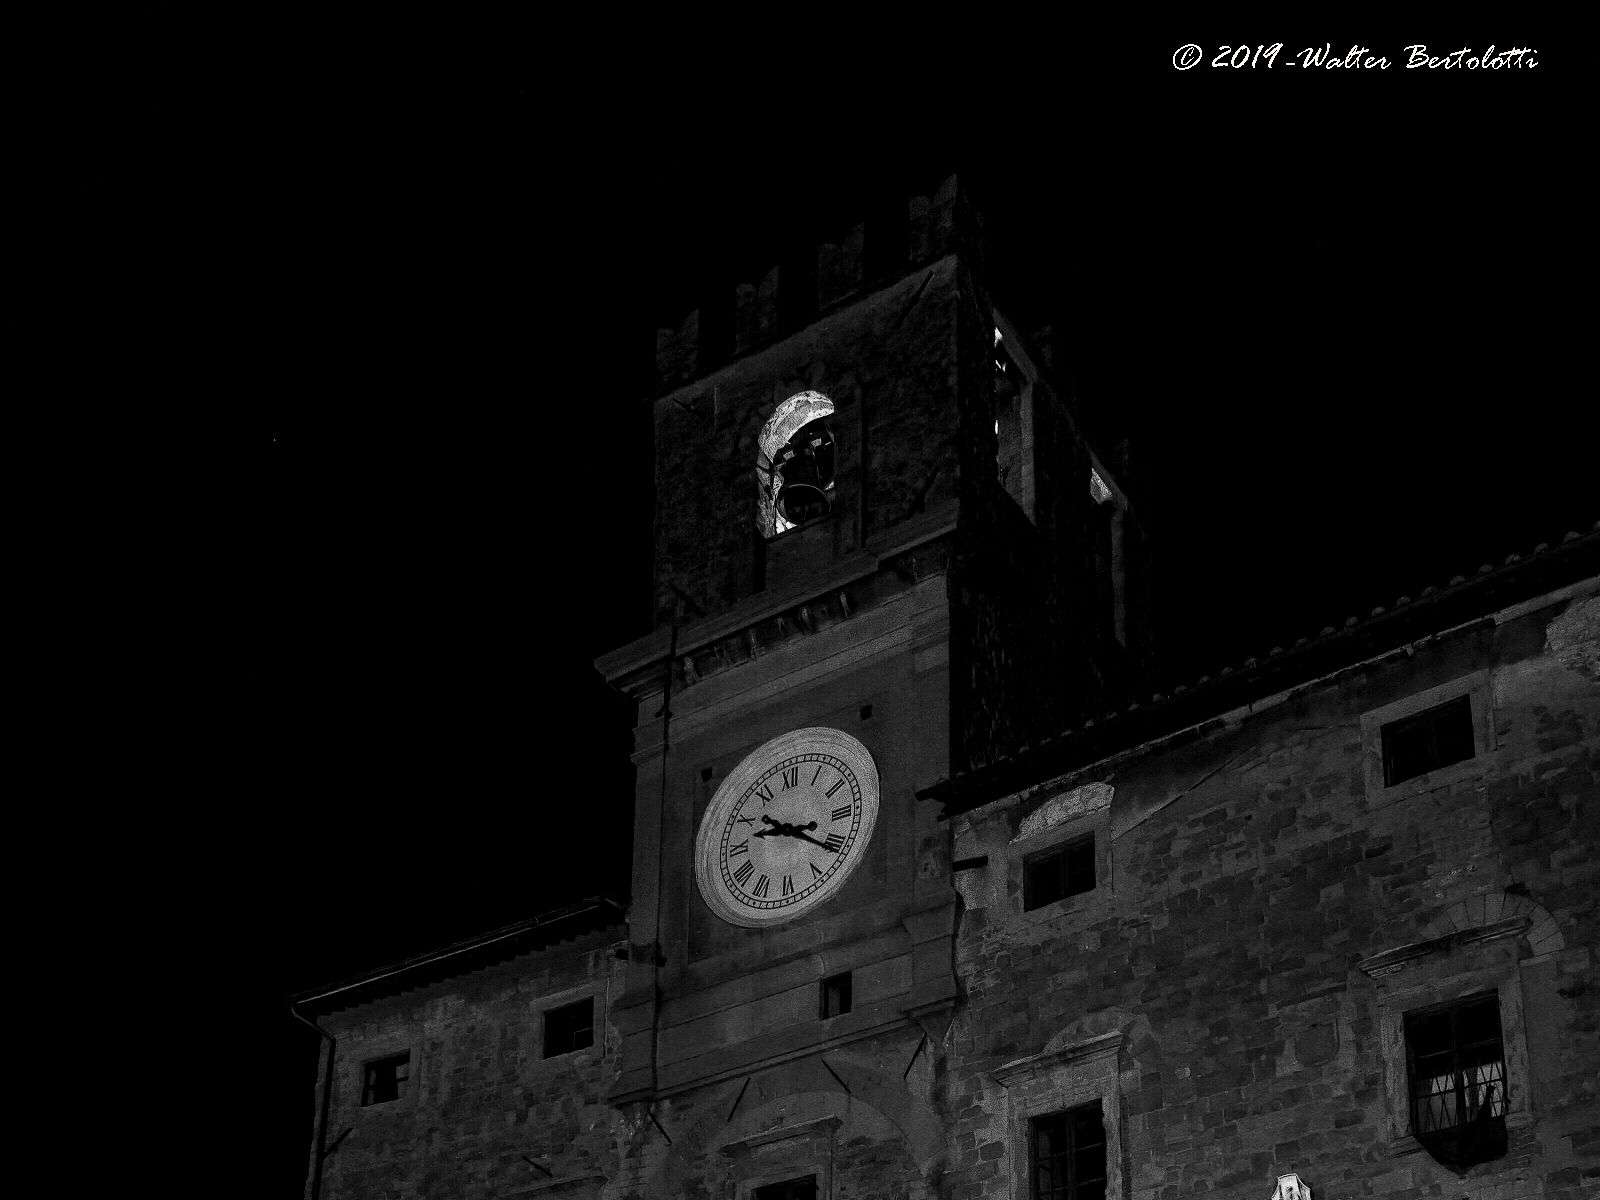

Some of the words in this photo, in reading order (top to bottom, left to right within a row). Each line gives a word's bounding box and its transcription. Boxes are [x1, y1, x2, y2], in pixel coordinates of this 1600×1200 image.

[782, 766, 799, 791] XII
[825, 778, 845, 798] II
[755, 783, 774, 807] XI
[737, 814, 756, 827] X
[831, 804, 852, 822] III
[729, 839, 749, 858] IX
[733, 860, 756, 888] VIII
[809, 862, 822, 880] V
[752, 874, 771, 898] VII
[781, 874, 795, 896] VI
